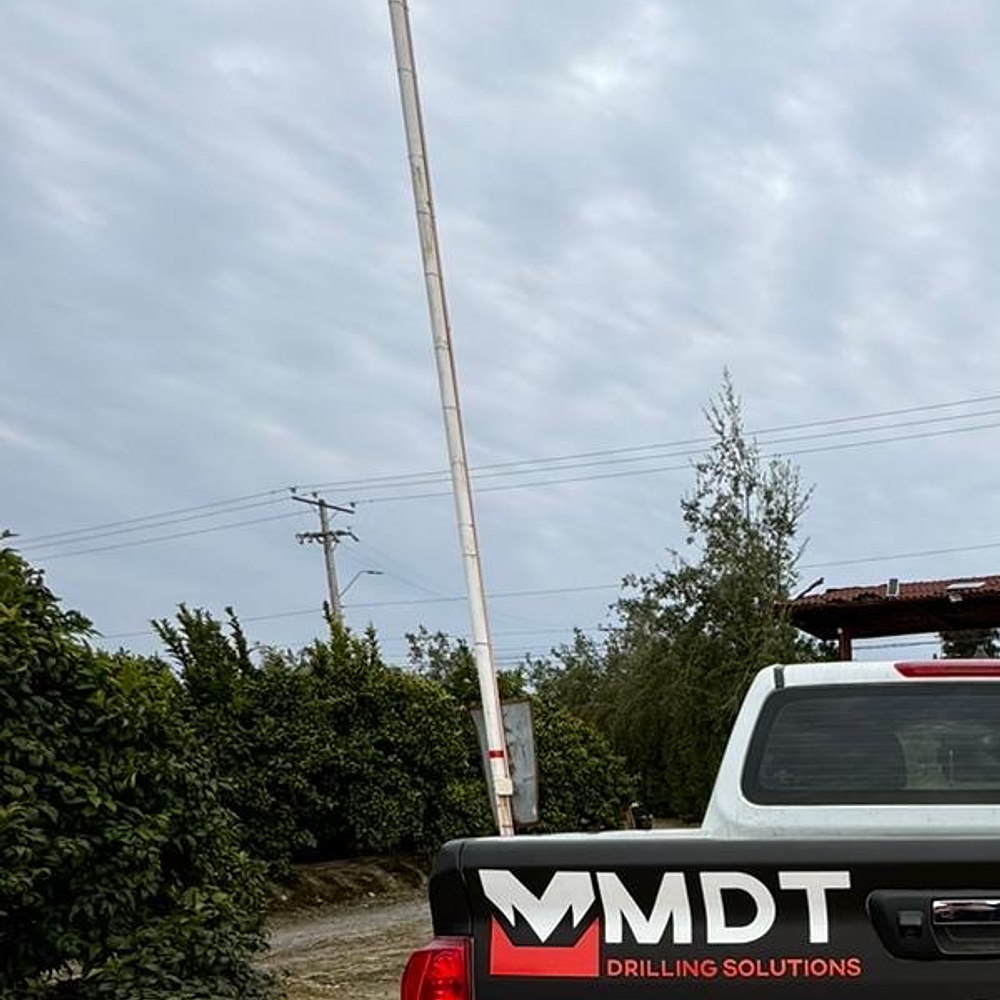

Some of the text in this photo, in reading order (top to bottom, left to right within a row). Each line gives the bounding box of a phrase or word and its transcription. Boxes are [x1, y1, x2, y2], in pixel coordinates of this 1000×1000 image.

[596, 872, 851, 944] MDT
[606, 957, 862, 979] DRILLING SOLUTIONS
